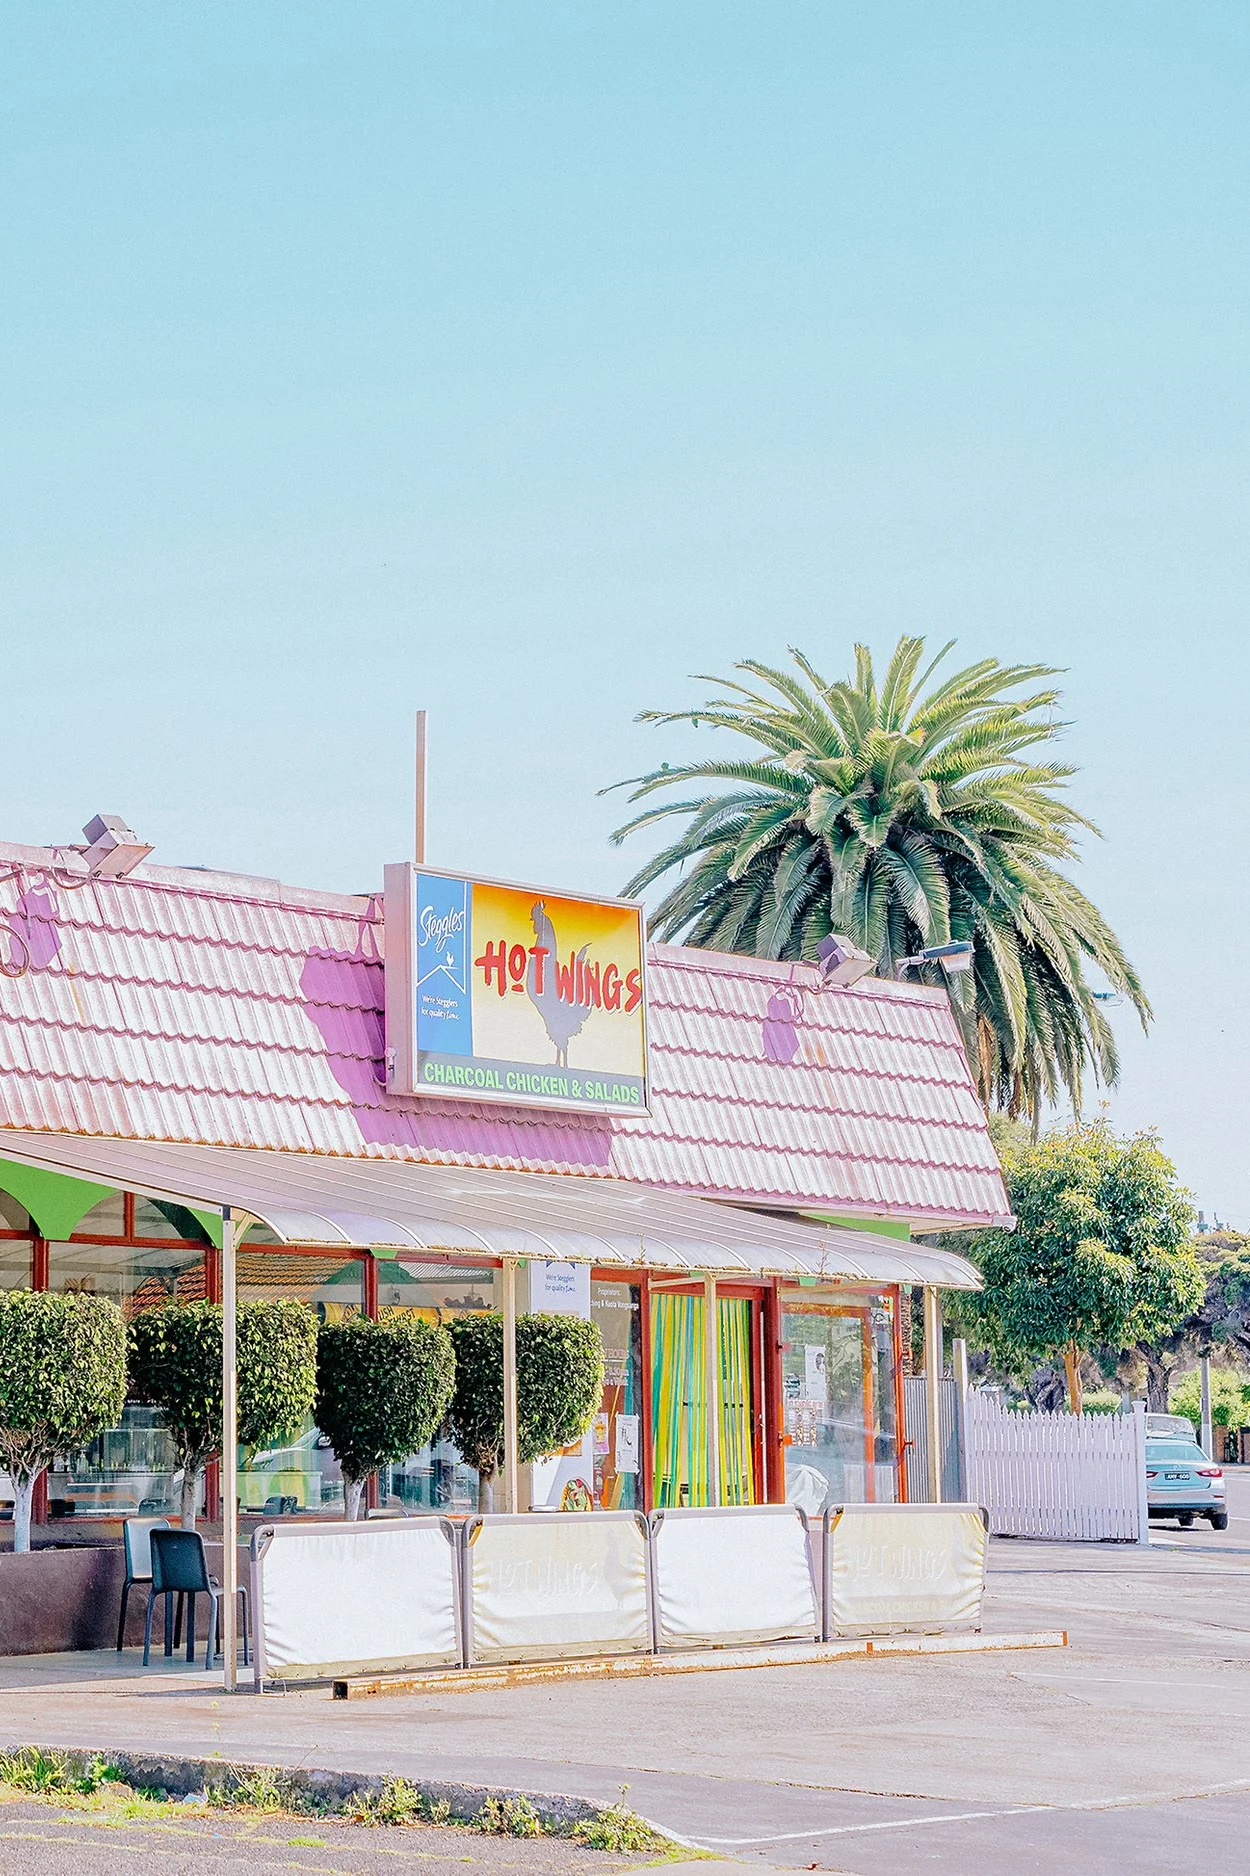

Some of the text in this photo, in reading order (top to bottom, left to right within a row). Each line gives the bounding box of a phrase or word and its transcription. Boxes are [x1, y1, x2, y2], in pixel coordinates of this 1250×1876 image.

[418, 905, 464, 953] Steggles
[474, 939, 643, 1014] HOT WINGS
[424, 1062, 640, 1105] CHARCOAL CHICKEN & SALADS
